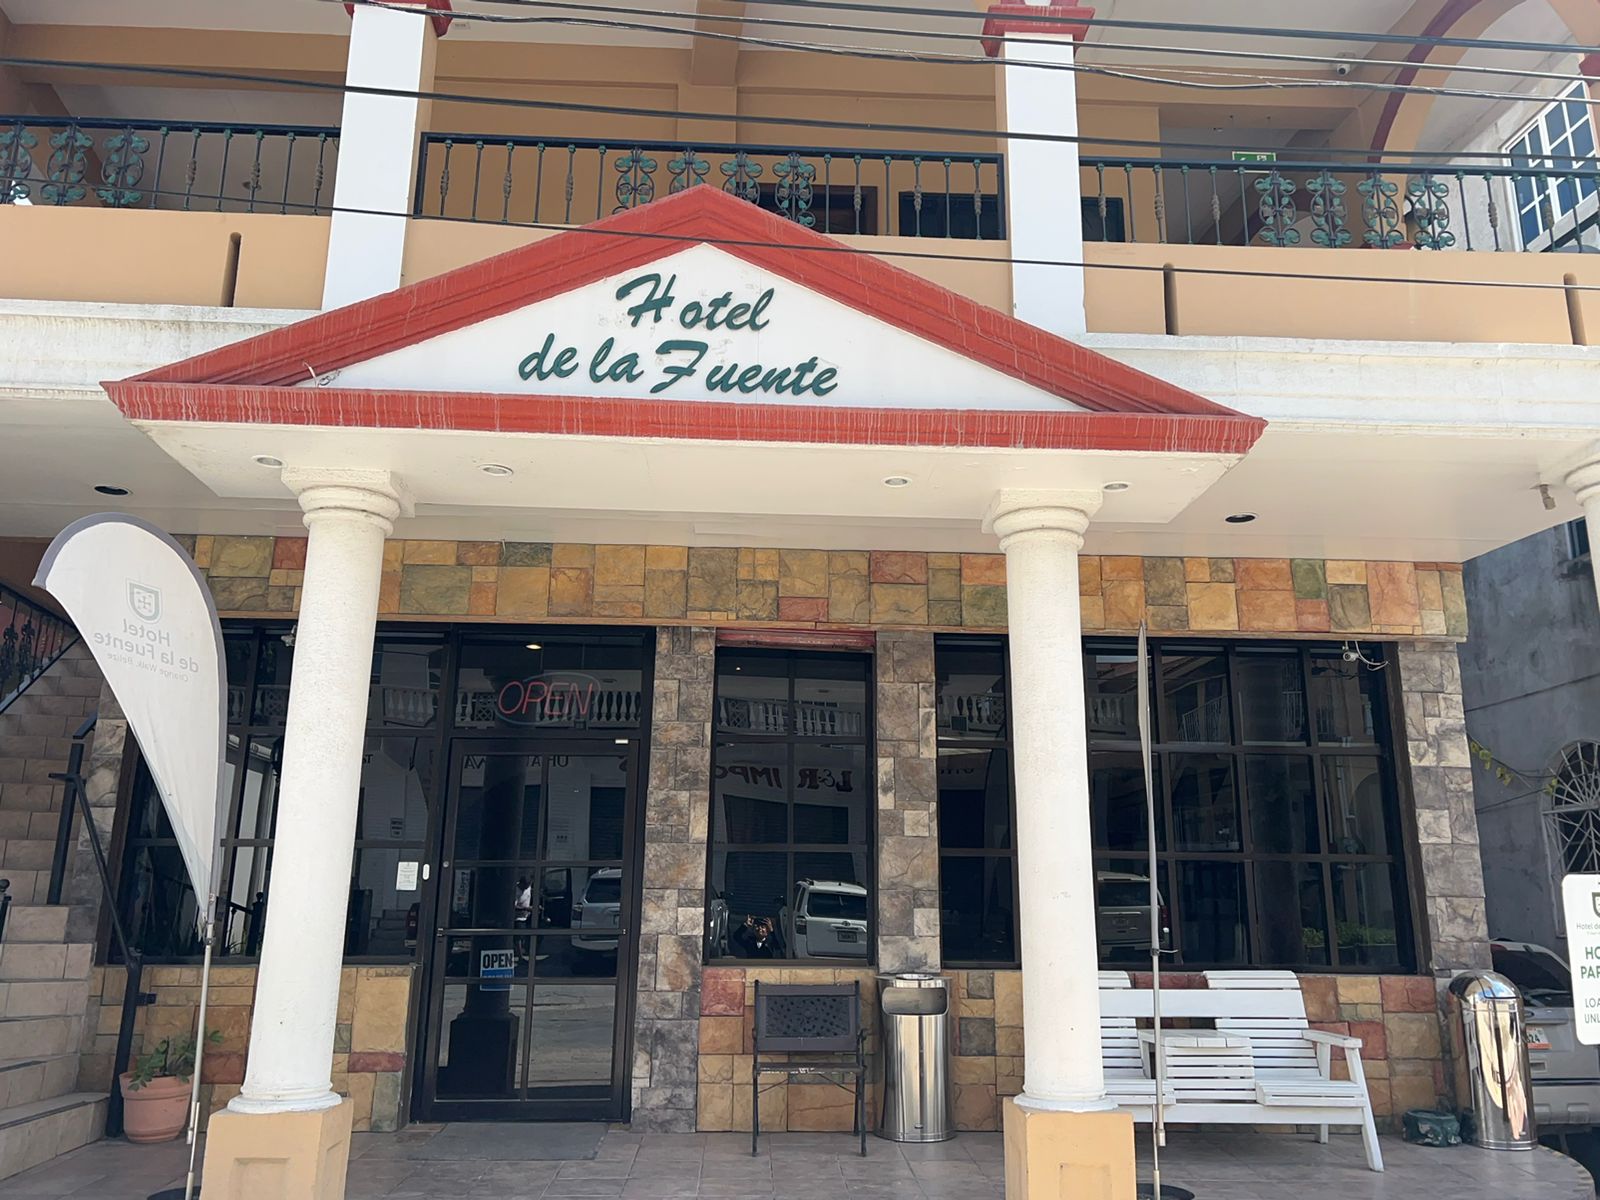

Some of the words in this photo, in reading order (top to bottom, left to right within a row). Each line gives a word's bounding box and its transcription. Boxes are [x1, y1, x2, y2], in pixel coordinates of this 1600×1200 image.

[615, 272, 775, 332] Hotel
[518, 333, 579, 381] de
[589, 337, 644, 383] la
[650, 340, 838, 395] Fuente
[498, 681, 593, 715] OPEN
[482, 953, 513, 969] OPEN
